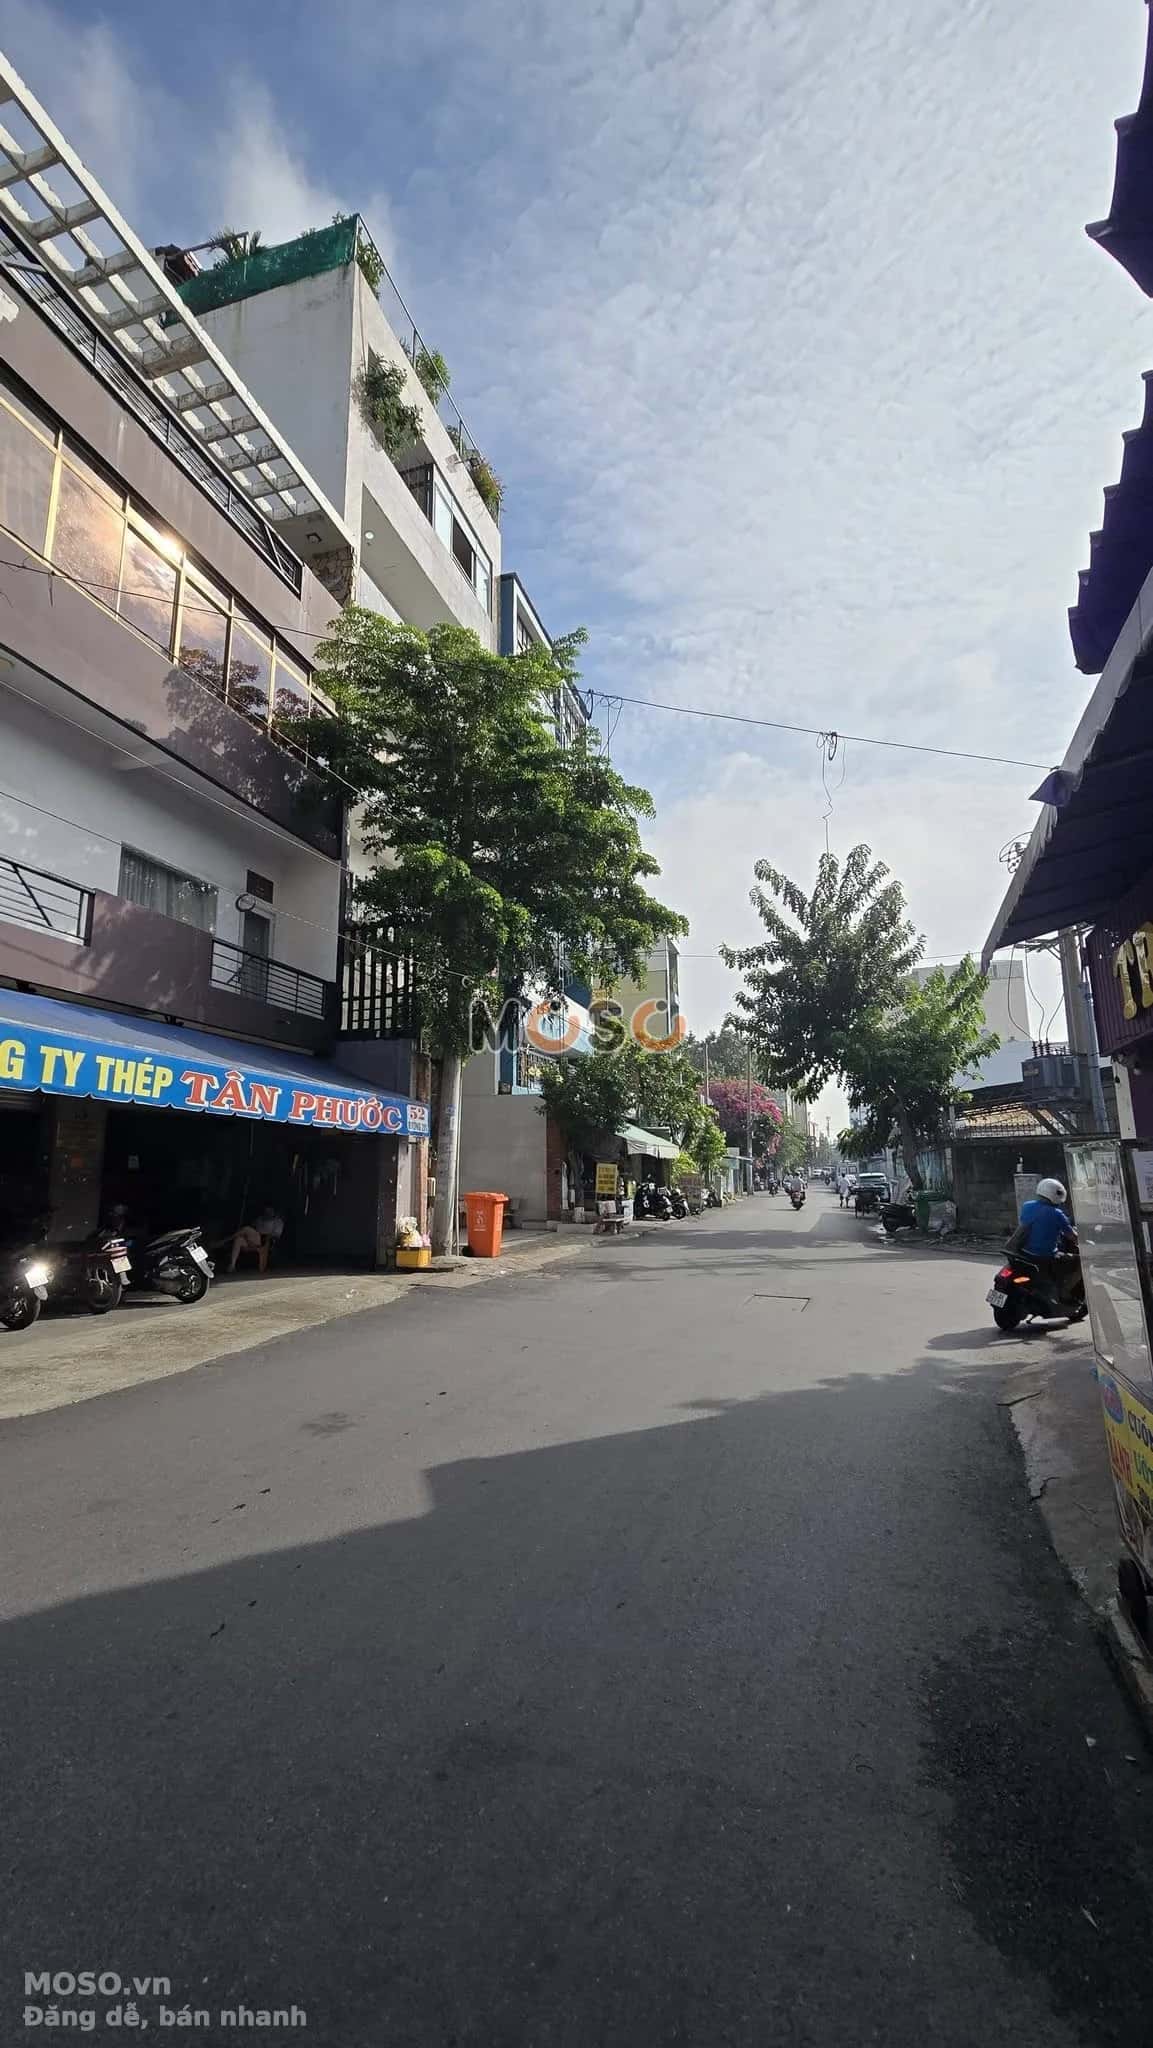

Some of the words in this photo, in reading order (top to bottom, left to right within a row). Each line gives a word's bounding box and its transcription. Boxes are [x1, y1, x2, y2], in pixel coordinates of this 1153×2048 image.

[40, 1045, 86, 1087] TY
[96, 1057, 173, 1098] THÉP
[181, 1069, 282, 1116] TÂN
[288, 1090, 402, 1130] PHƯỚC
